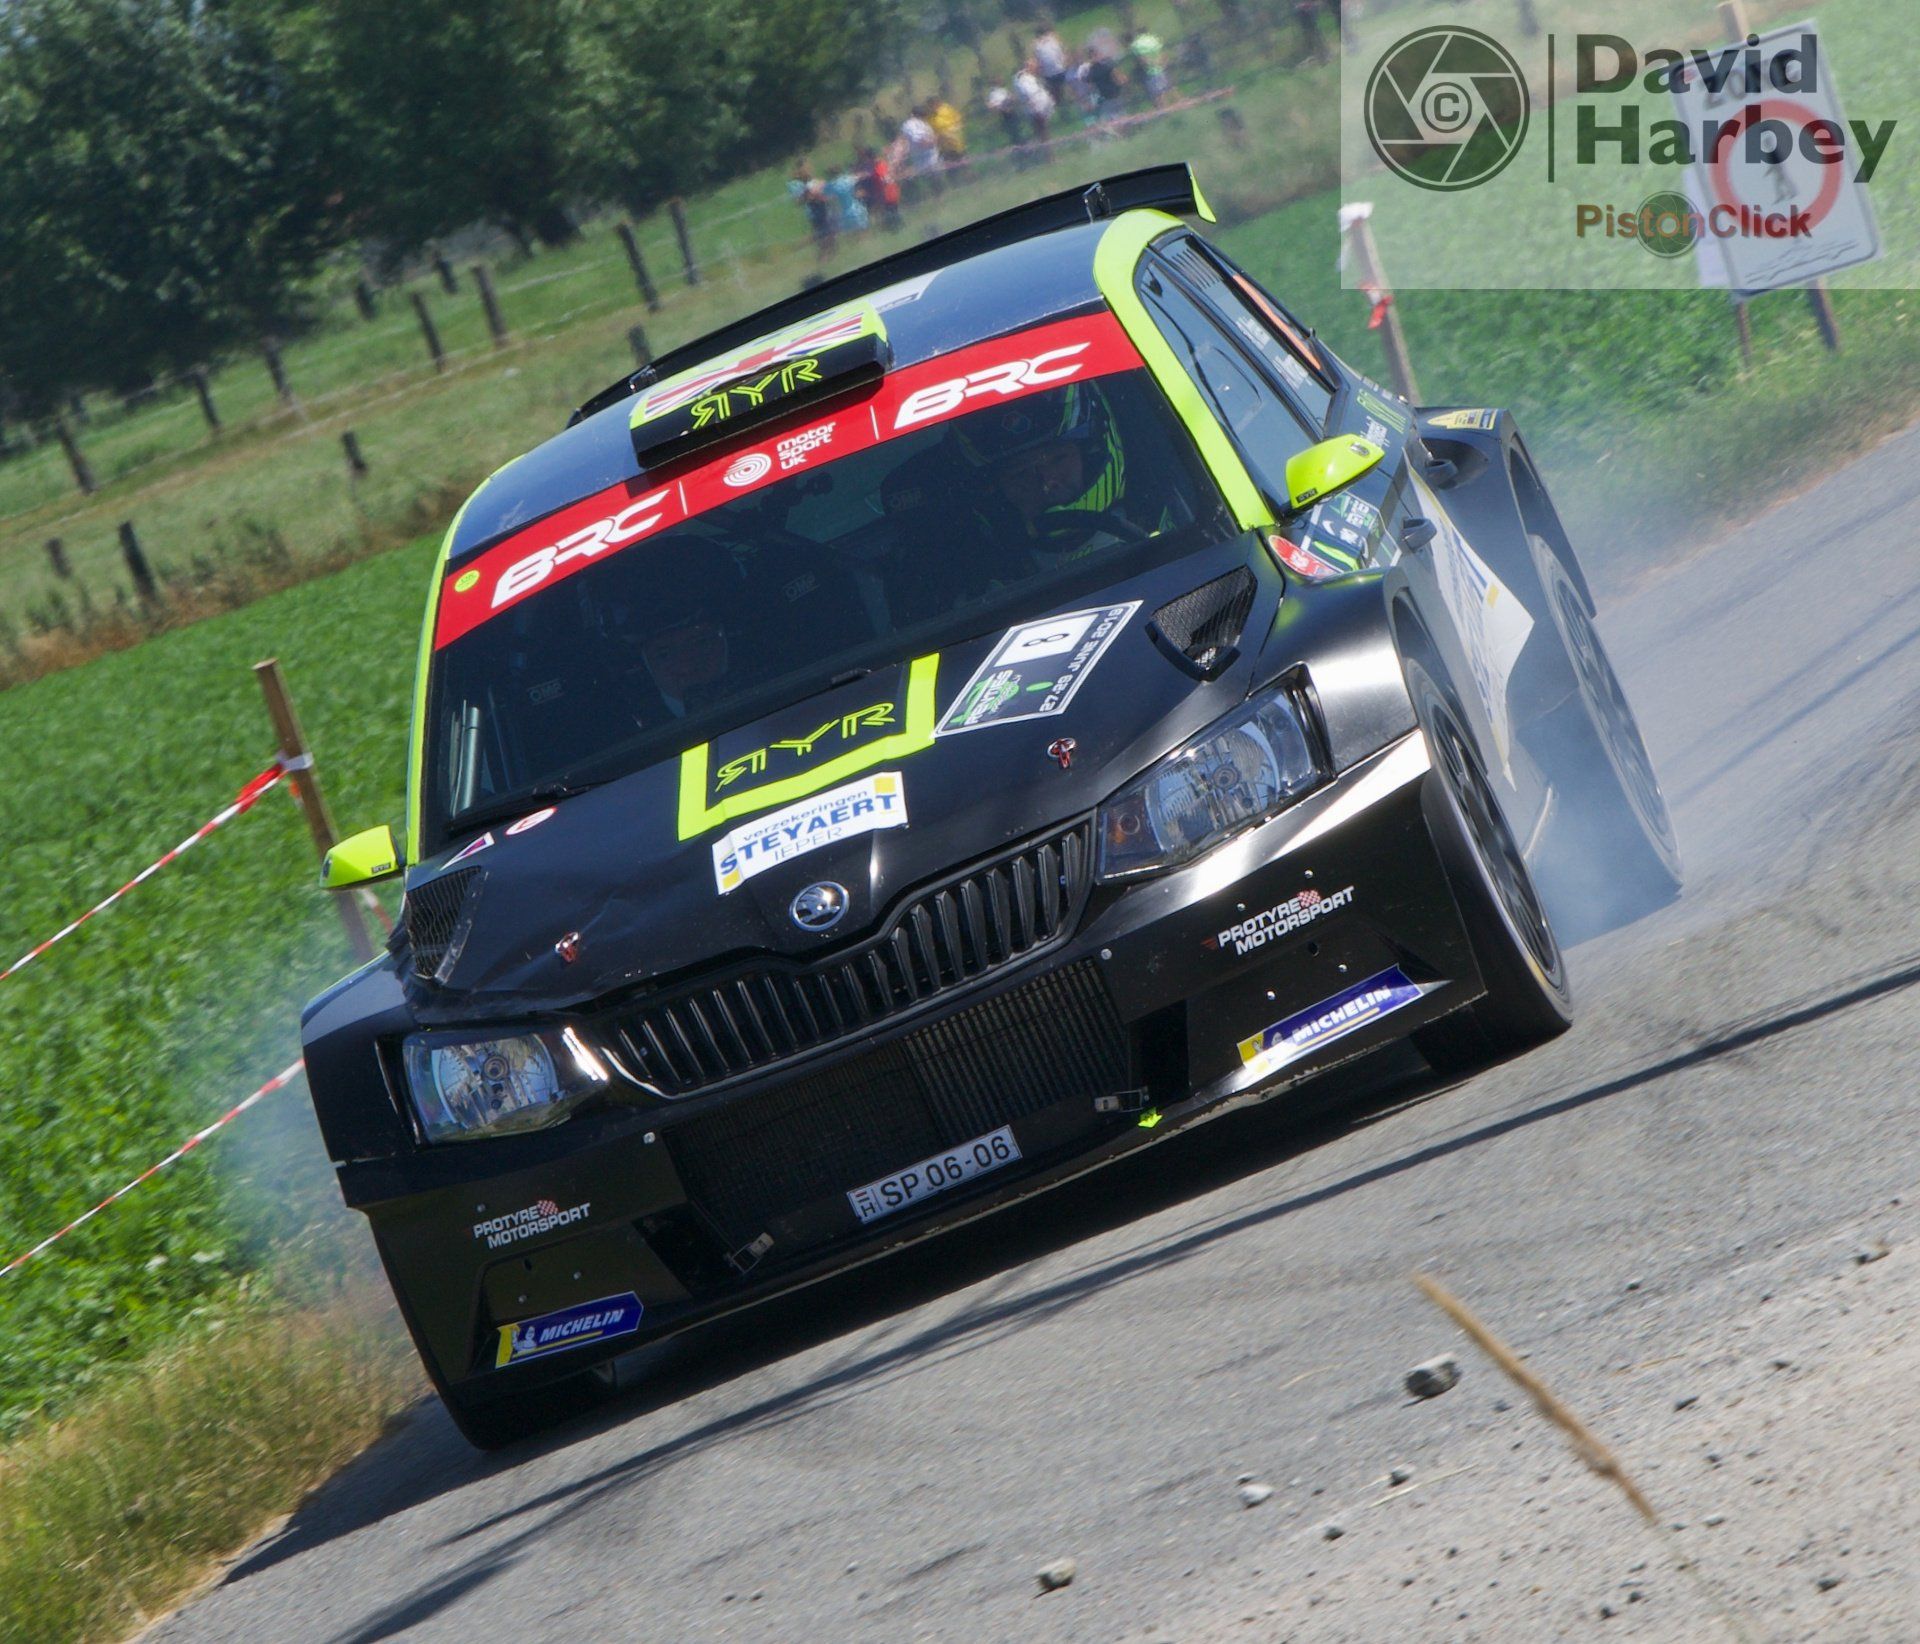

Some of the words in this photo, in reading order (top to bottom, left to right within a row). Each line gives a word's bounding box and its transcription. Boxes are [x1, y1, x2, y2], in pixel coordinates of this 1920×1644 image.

[894, 342, 1091, 430] BRC
[777, 422, 836, 452] motor
[779, 434, 832, 460] sport
[781, 454, 806, 470] UK
[491, 490, 669, 608] BRC
[1022, 633, 1069, 648] 8
[1068, 640, 1099, 672] JUNE
[720, 795, 897, 875] STEYAERT
[743, 790, 867, 841] verzekeringen
[775, 827, 841, 862] IEPER
[1218, 897, 1303, 947] PROTYRE
[1236, 886, 1355, 955] MOTORSPORT
[1292, 988, 1391, 1042] MICHELIN
[880, 1172, 919, 1206] SP
[926, 1135, 1010, 1187] 06-06
[473, 1205, 540, 1239] PROTYRE
[487, 1203, 591, 1249] MOTORSPORT
[861, 1202, 876, 1218] H
[540, 1308, 624, 1343] MICHELIN
